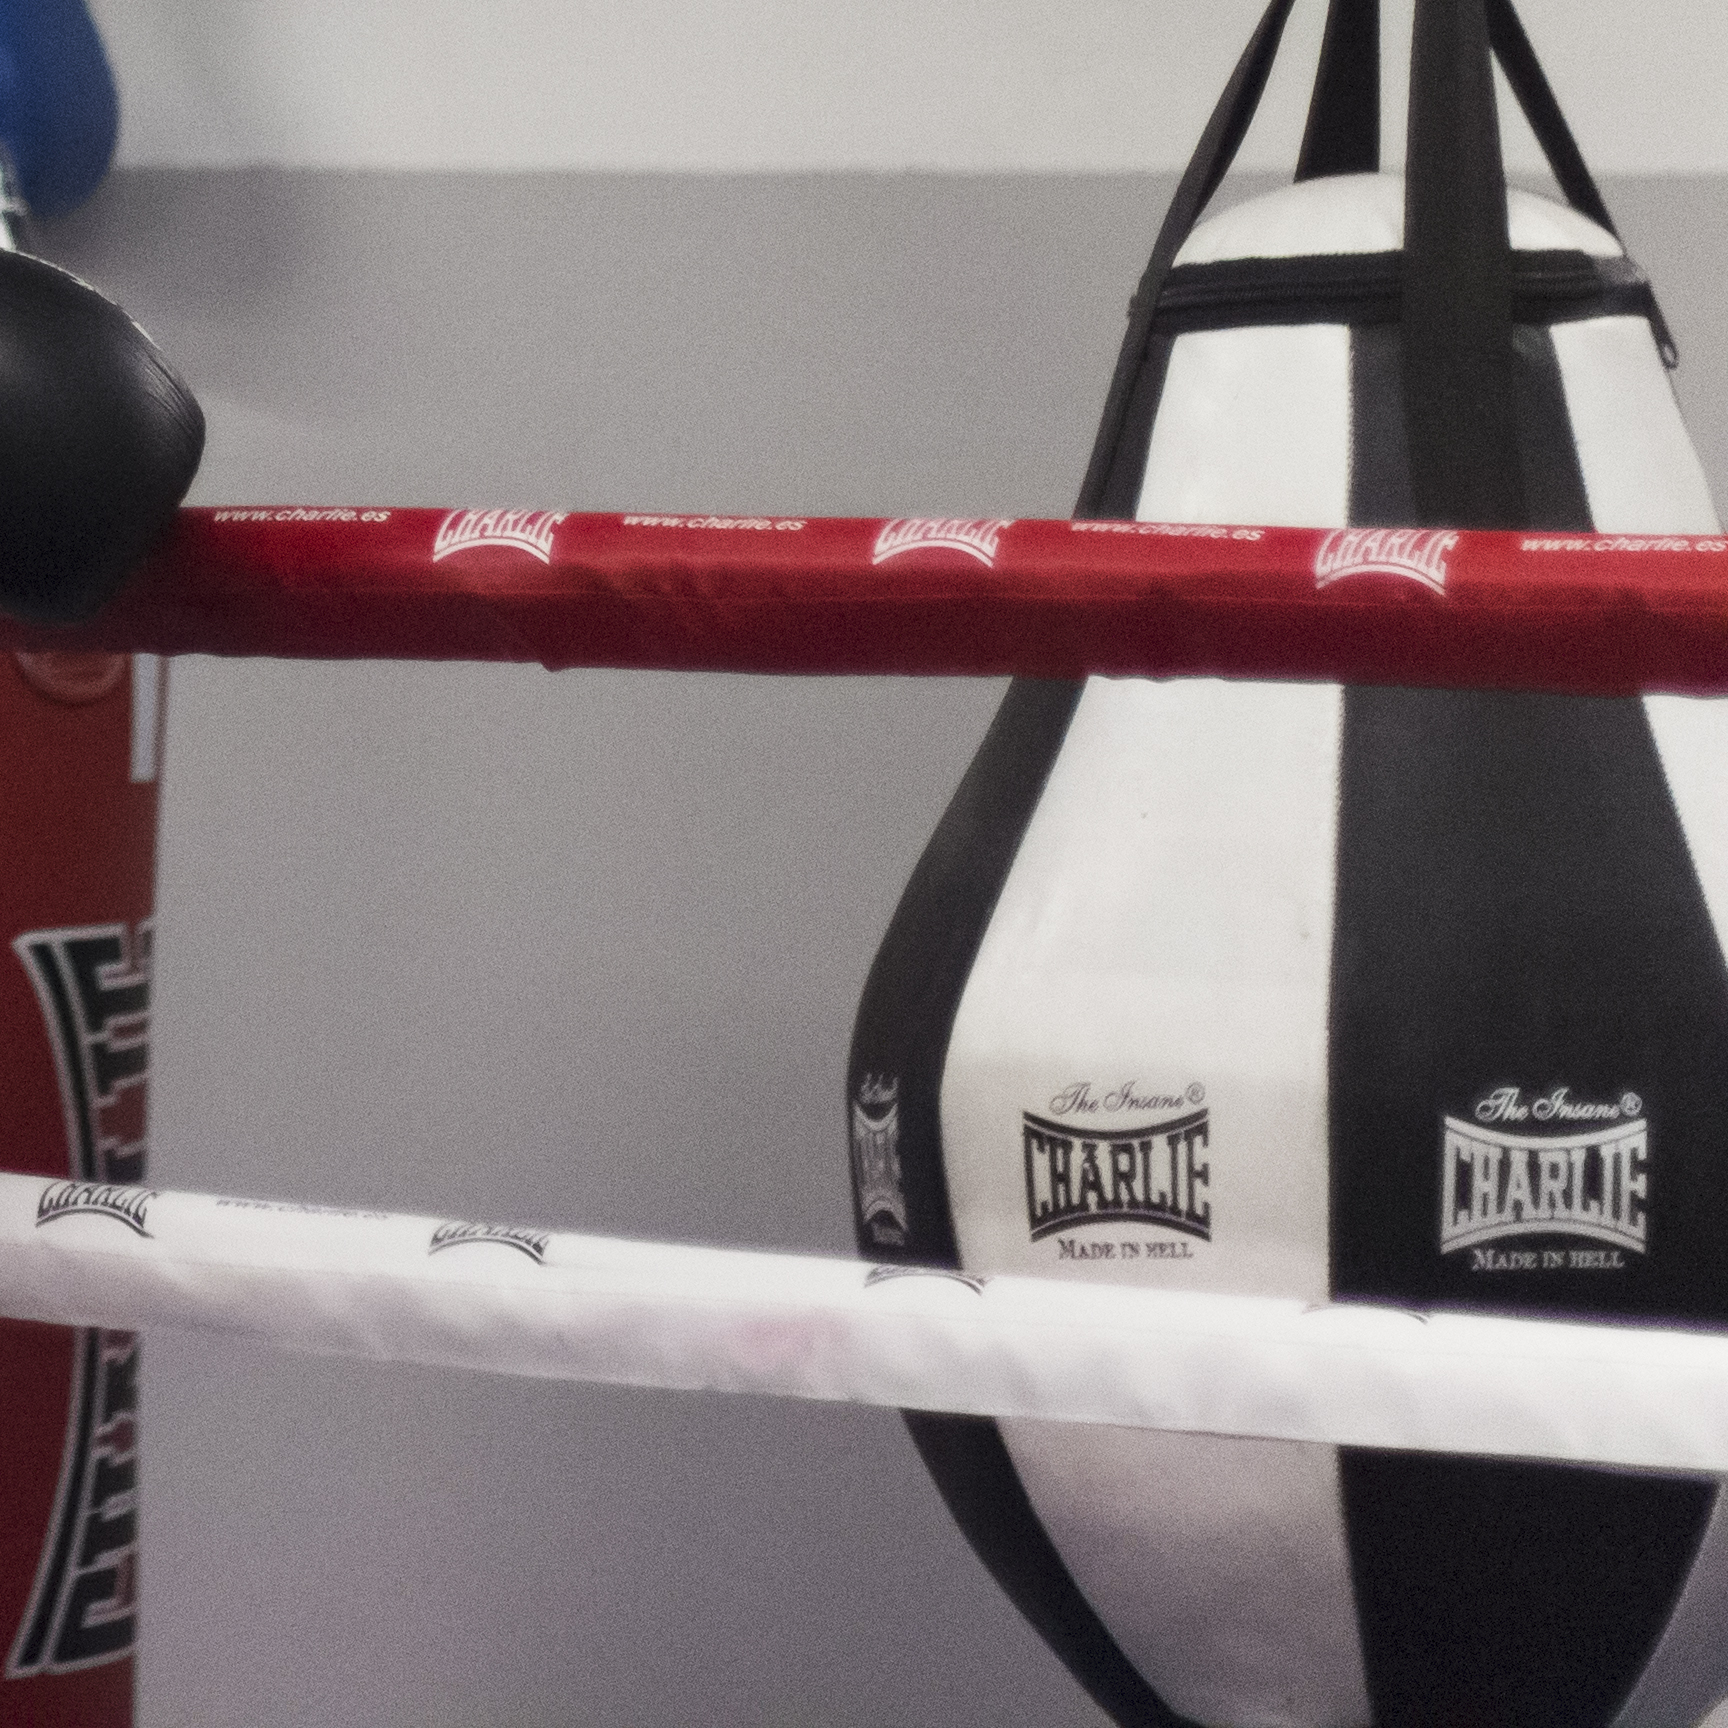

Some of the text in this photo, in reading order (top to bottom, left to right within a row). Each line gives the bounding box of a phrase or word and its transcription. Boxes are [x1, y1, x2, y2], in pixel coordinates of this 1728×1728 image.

[1049, 1079, 1185, 1115] The Insane
[1475, 1086, 1621, 1122] The Insane
[1023, 1120, 1212, 1232] CHARLIE
[1441, 1128, 1648, 1247] CHARLIE
[1058, 1238, 1116, 1260] MADE
[1121, 1241, 1142, 1260] IN
[1472, 1248, 1625, 1271] MADE IN HELL
